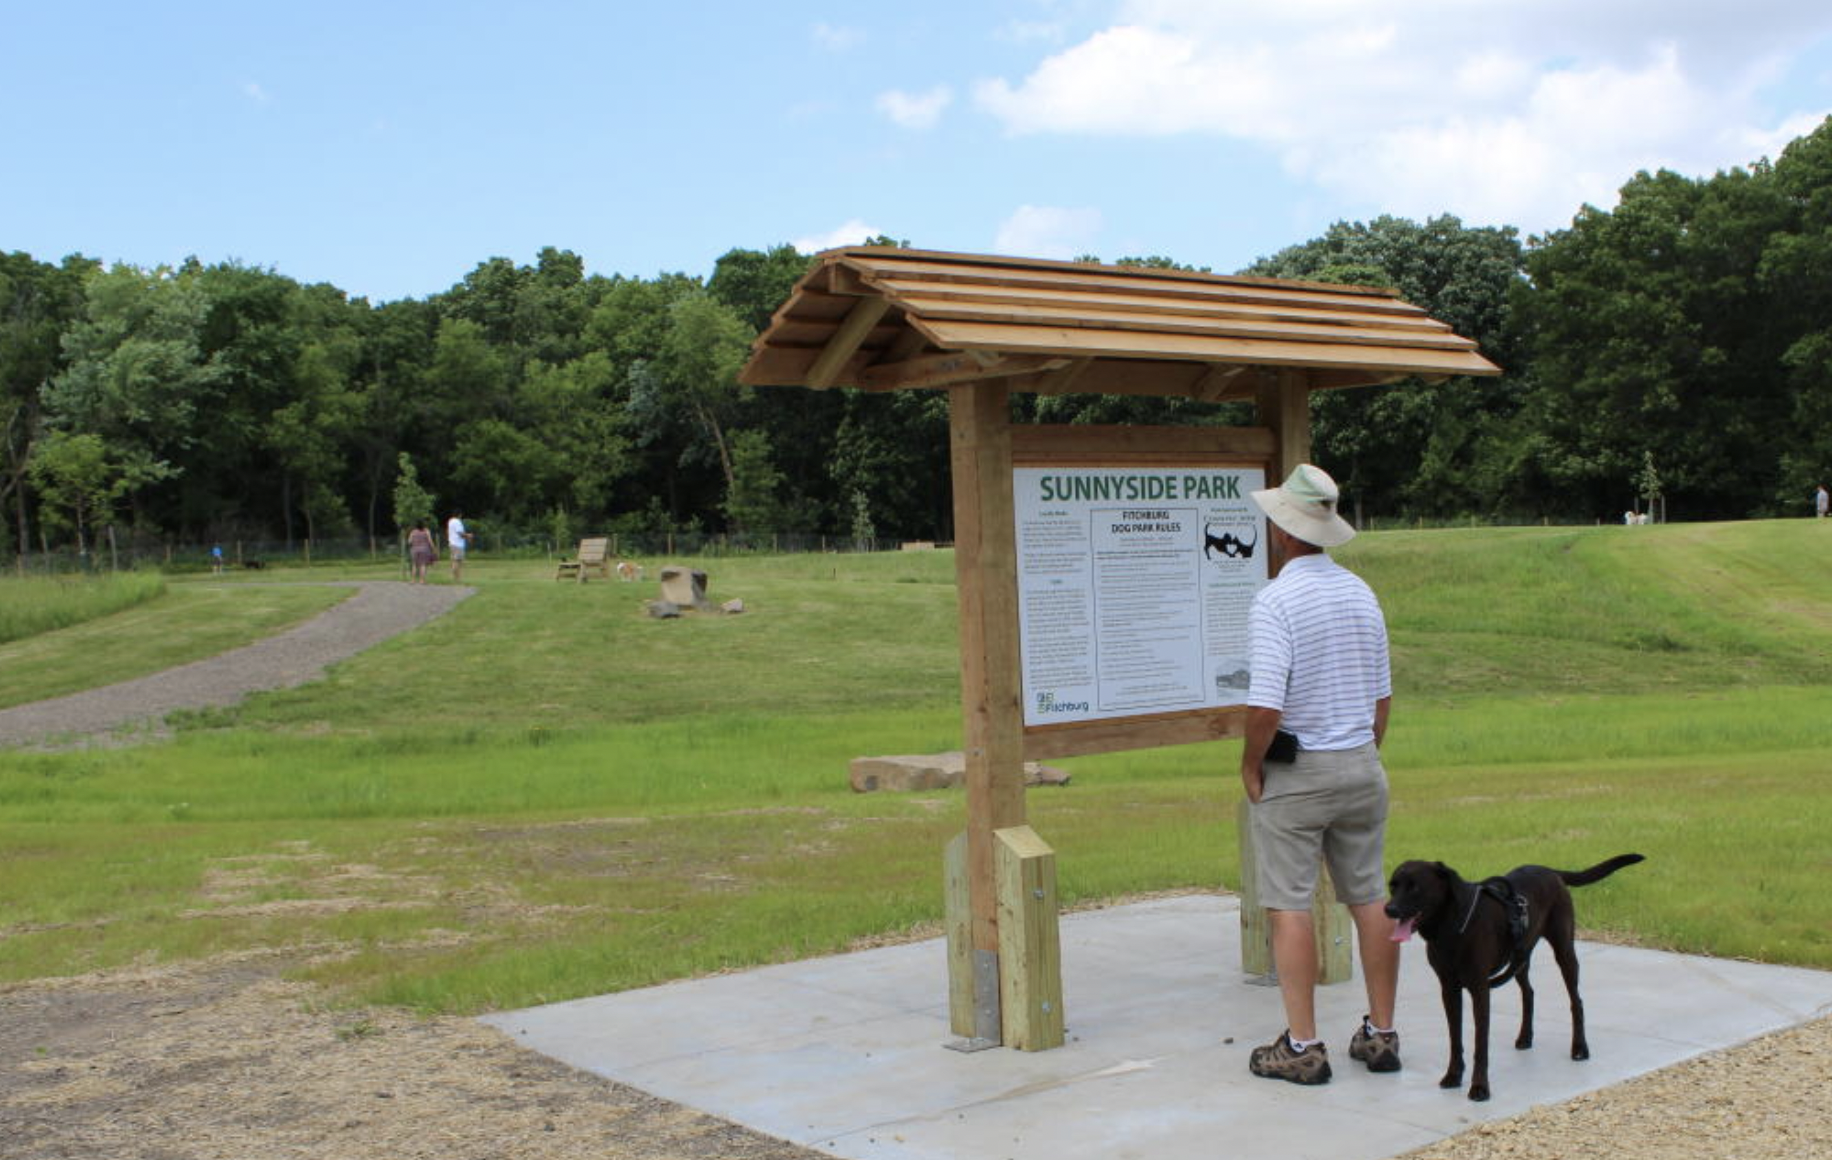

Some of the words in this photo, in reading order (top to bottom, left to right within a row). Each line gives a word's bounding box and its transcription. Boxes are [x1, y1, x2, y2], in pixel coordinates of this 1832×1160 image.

[1040, 476, 1178, 501] SUNNYSIDE
[1183, 475, 1241, 500] PARK
[1122, 511, 1170, 521] FITCHBURG
[1111, 524, 1131, 534] DOG
[1132, 523, 1154, 533] PARK
[1155, 522, 1182, 532] RULES
